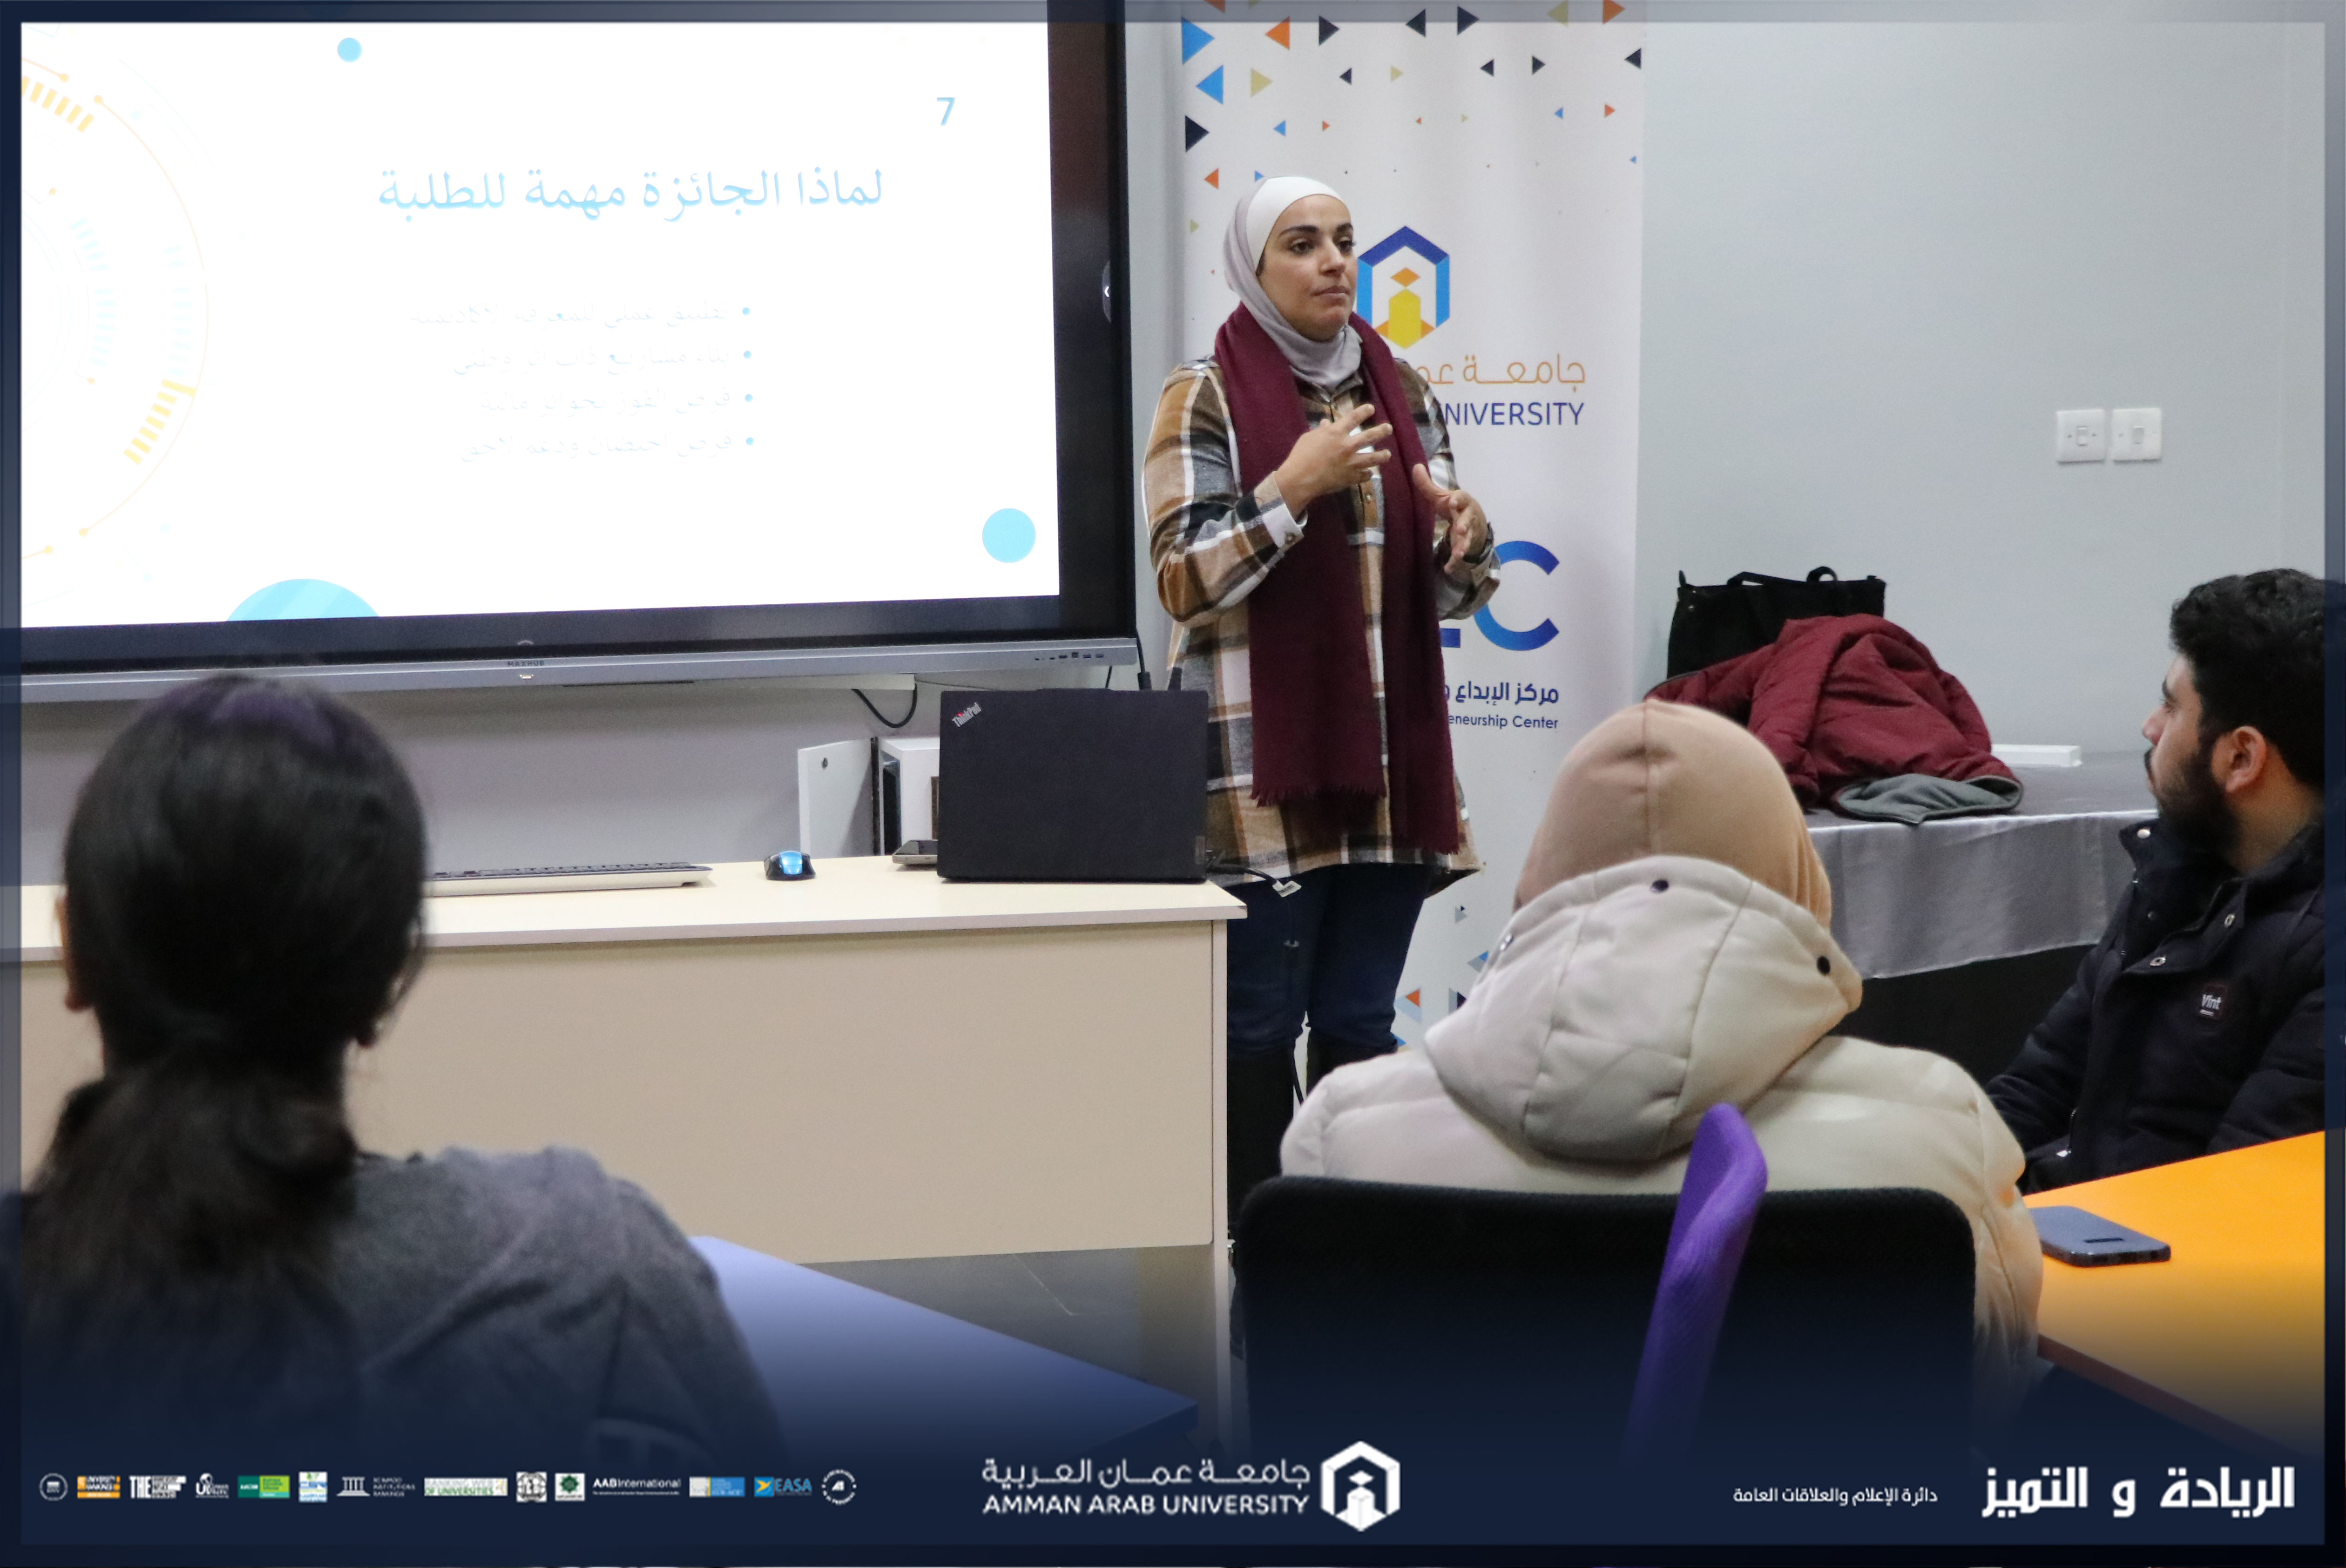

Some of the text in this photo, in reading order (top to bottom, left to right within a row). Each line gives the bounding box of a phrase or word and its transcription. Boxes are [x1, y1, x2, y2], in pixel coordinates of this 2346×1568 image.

[937, 97, 955, 126] 7
[379, 166, 882, 223] لماذا الجائزة مهمة للطلبة
[1463, 354, 1585, 392] جامعة
[1446, 402, 1584, 426] NIVERSITY
[1455, 681, 1510, 706] الإبداع
[1514, 683, 1559, 706] مركز
[952, 702, 982, 728] ThinkPad
[1448, 715, 1559, 730] eneurship Center
